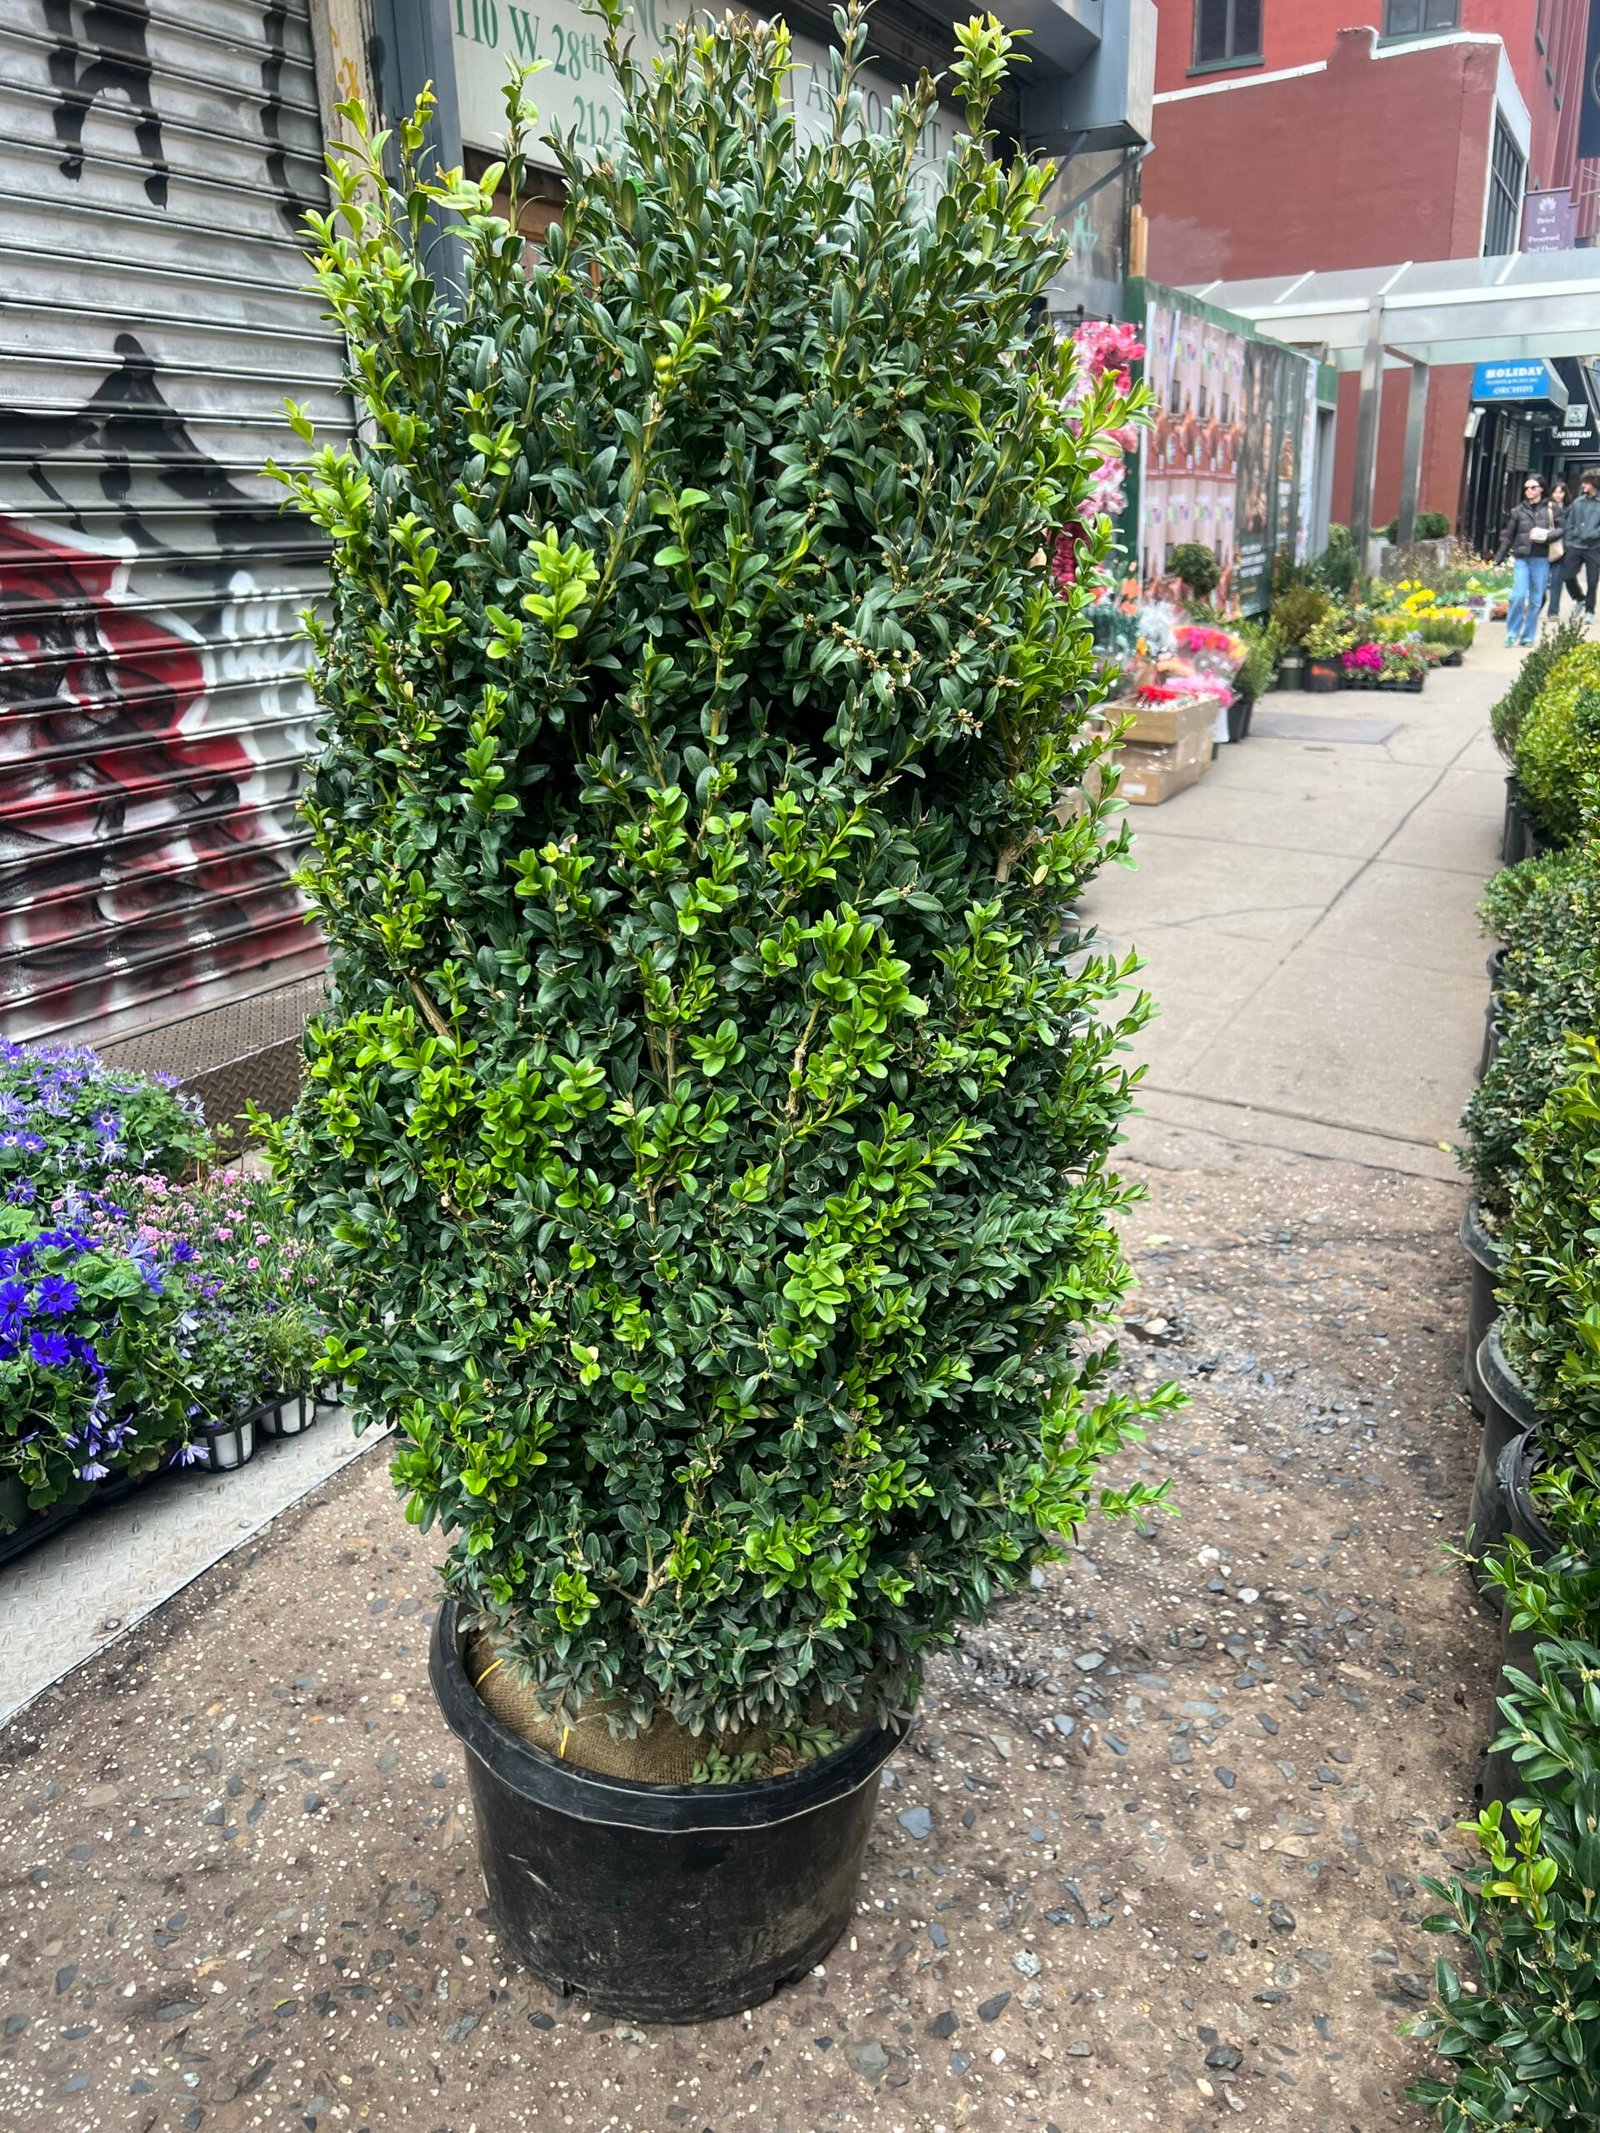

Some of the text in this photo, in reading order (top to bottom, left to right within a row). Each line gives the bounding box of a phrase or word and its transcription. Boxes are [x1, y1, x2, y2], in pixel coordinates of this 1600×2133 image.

[552, 24, 606, 81] 28th
[1485, 366, 1544, 379] HOLIDAY
[1493, 385, 1534, 395] ORCHIDS
[1561, 439, 1581, 447] CUTS
